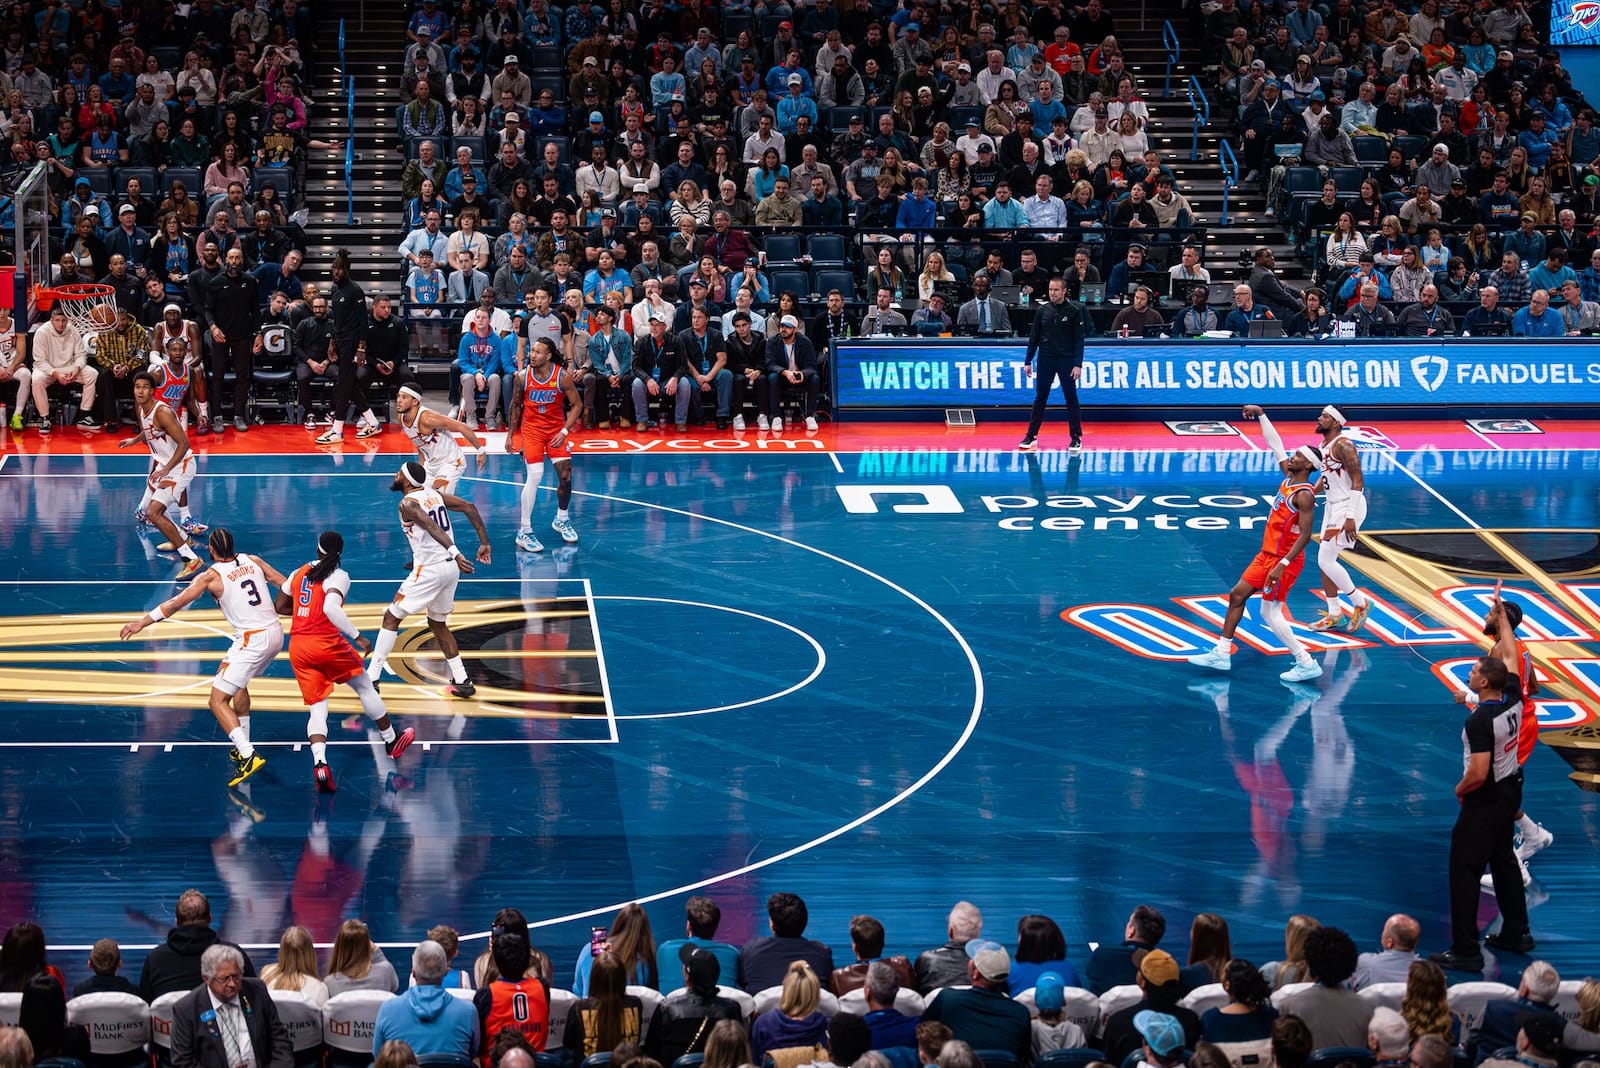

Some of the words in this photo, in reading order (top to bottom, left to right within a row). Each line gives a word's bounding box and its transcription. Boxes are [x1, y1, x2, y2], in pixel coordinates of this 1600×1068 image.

[1570, 6, 1599, 25] OKC
[263, 329, 285, 353] G
[860, 361, 949, 390] WATCH
[955, 361, 1004, 390] THE
[1009, 360, 1130, 390] THDER
[1135, 360, 1181, 389] ALL
[1185, 360, 1286, 389] SEASON
[1292, 360, 1359, 389] LONG
[1365, 360, 1400, 388] ON
[1456, 363, 1583, 385] FANDUEL
[528, 389, 557, 404] OKC
[568, 437, 825, 452] aycom
[226, 565, 255, 582] BROOKS
[240, 579, 262, 607] 3
[300, 575, 314, 606] 5
[512, 991, 529, 1022] 0
[93, 1030, 125, 1040] BANK
[353, 1031, 375, 1039] BAN
